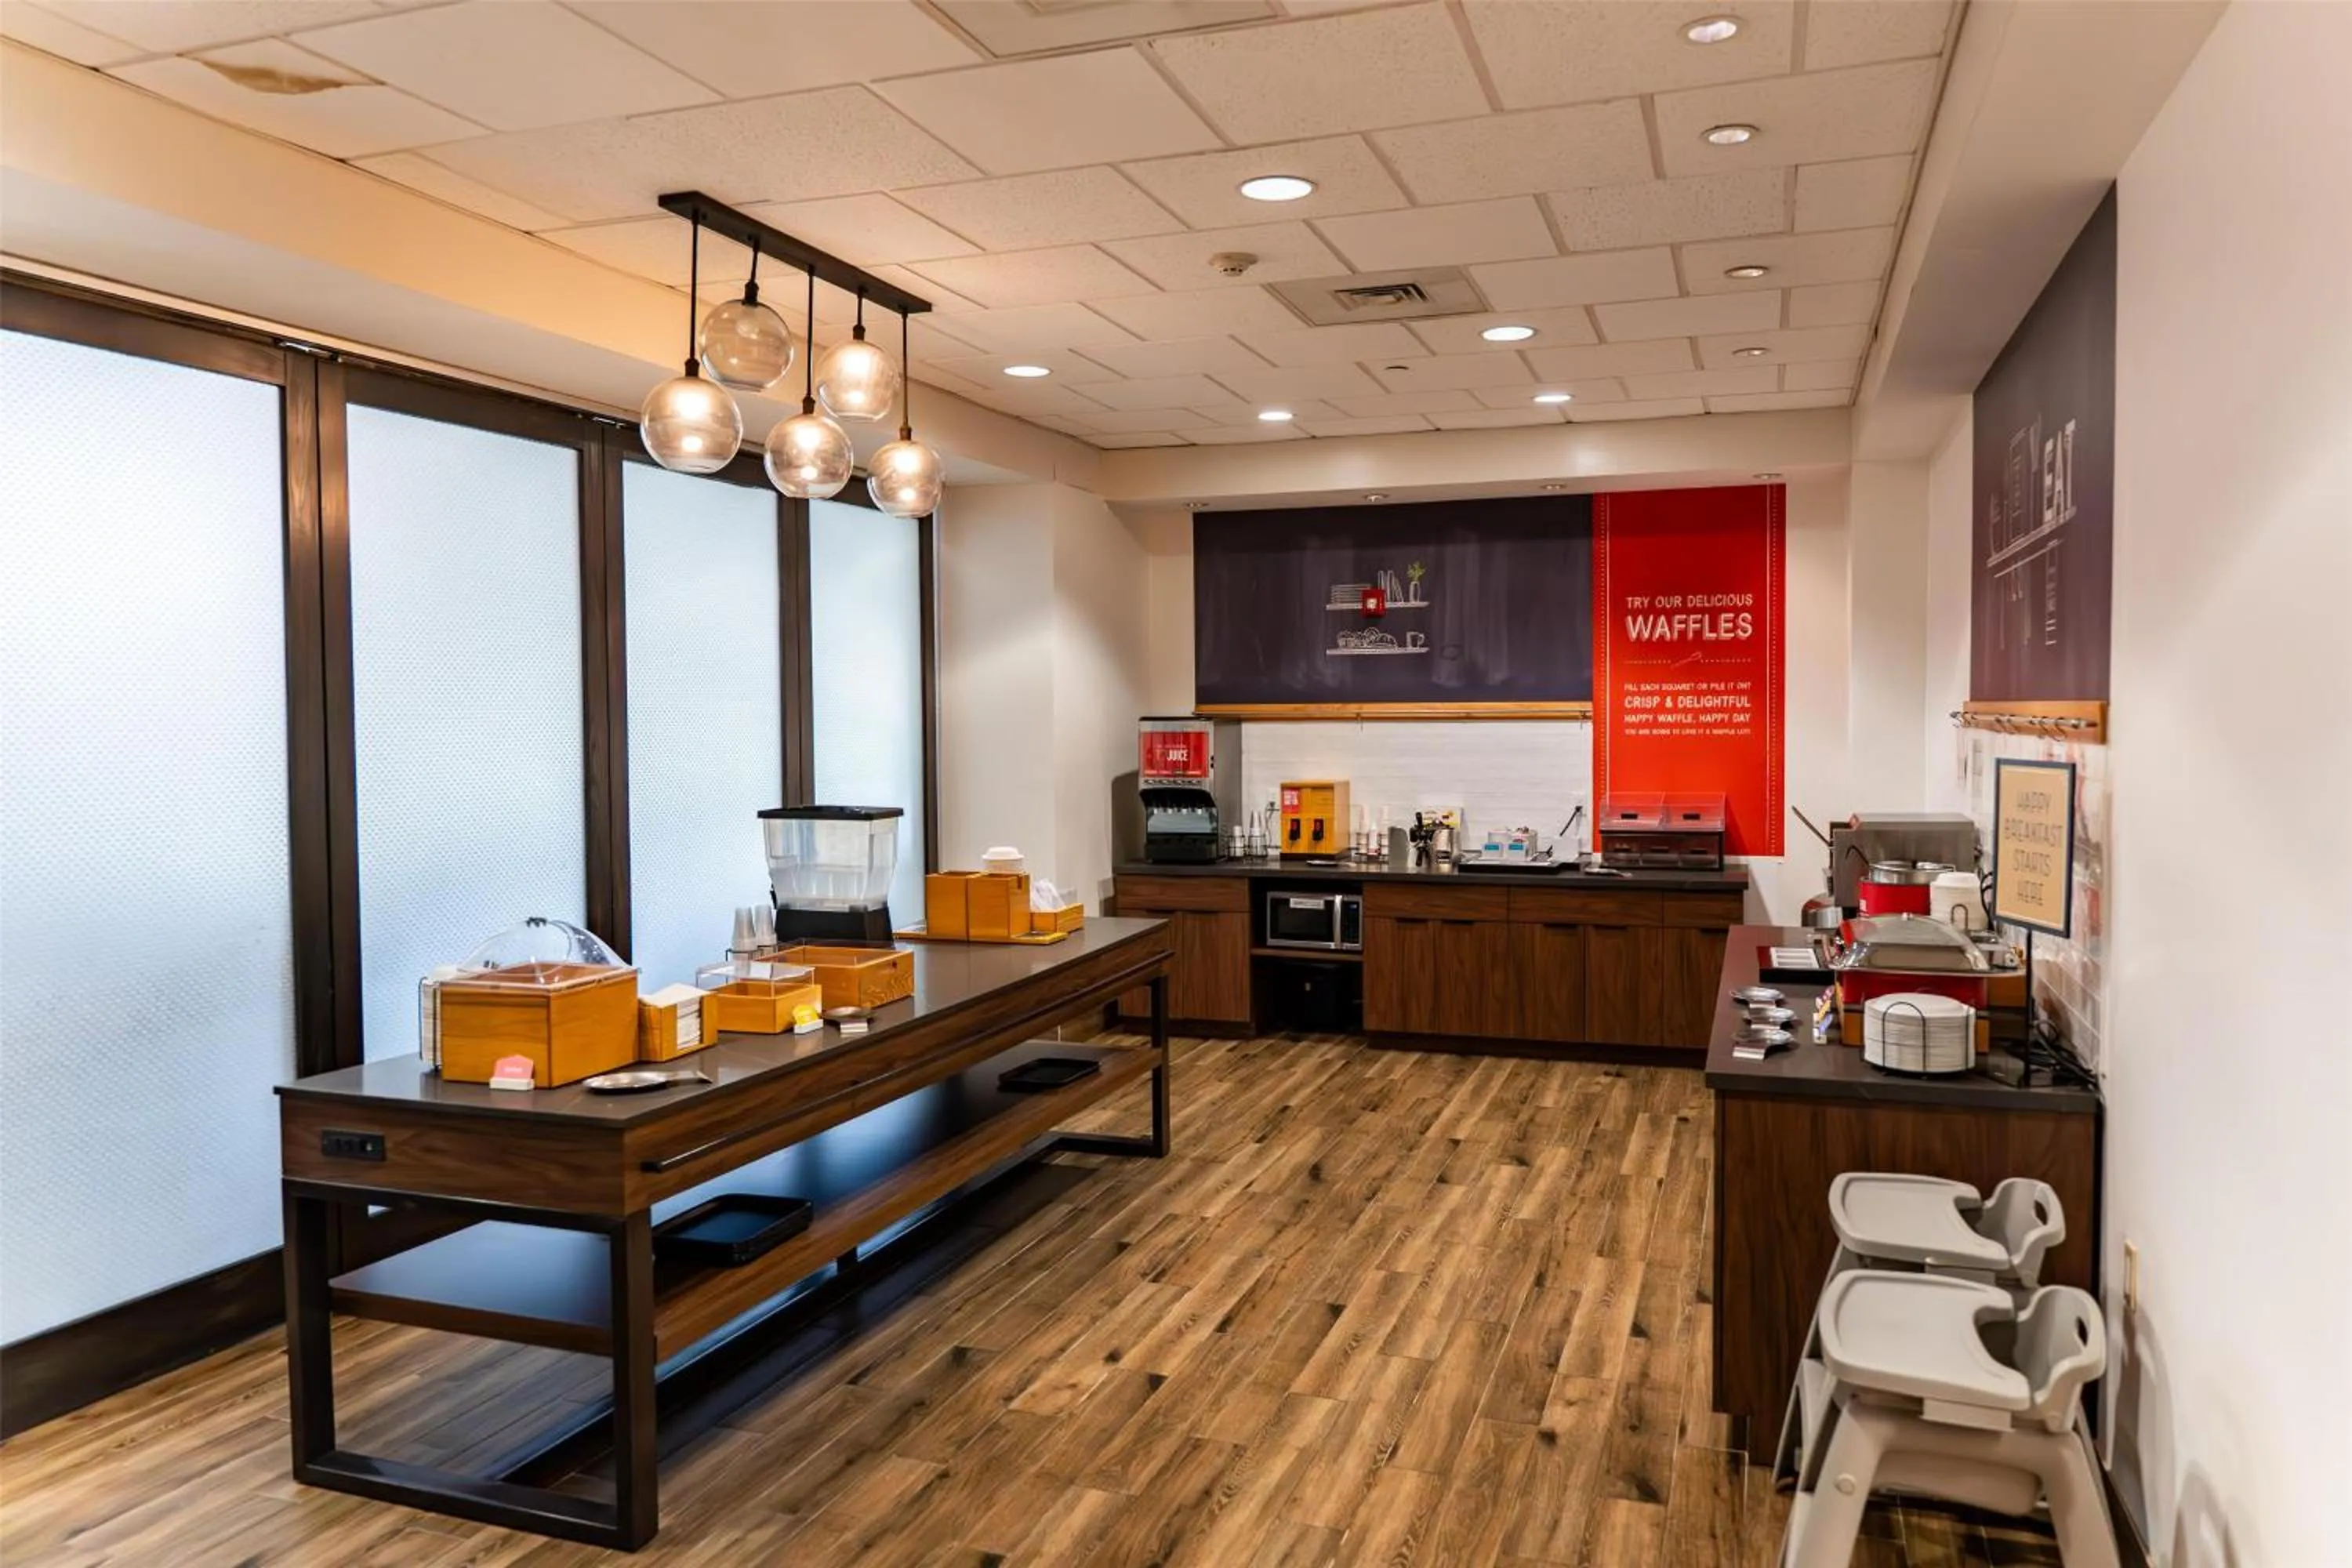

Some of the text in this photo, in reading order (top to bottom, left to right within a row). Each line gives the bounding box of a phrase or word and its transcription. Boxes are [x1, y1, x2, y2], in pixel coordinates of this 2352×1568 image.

[2044, 418, 2076, 524] EAT
[1626, 593, 1753, 609] TRY OUR DELICIOUS
[1626, 612, 1753, 641] WAFFLES
[1624, 696, 1751, 708] CRISP & DELIGHTFUL
[1624, 713, 1751, 724] HAPPY WAFFLE, HAPPY DAY
[1167, 749, 1189, 761] JUICE
[2016, 791, 2053, 815] HAPPY
[2005, 818, 2063, 848] BREAKFAST
[2013, 848, 2053, 877] STARTS
[2017, 880, 2044, 907] HERE
